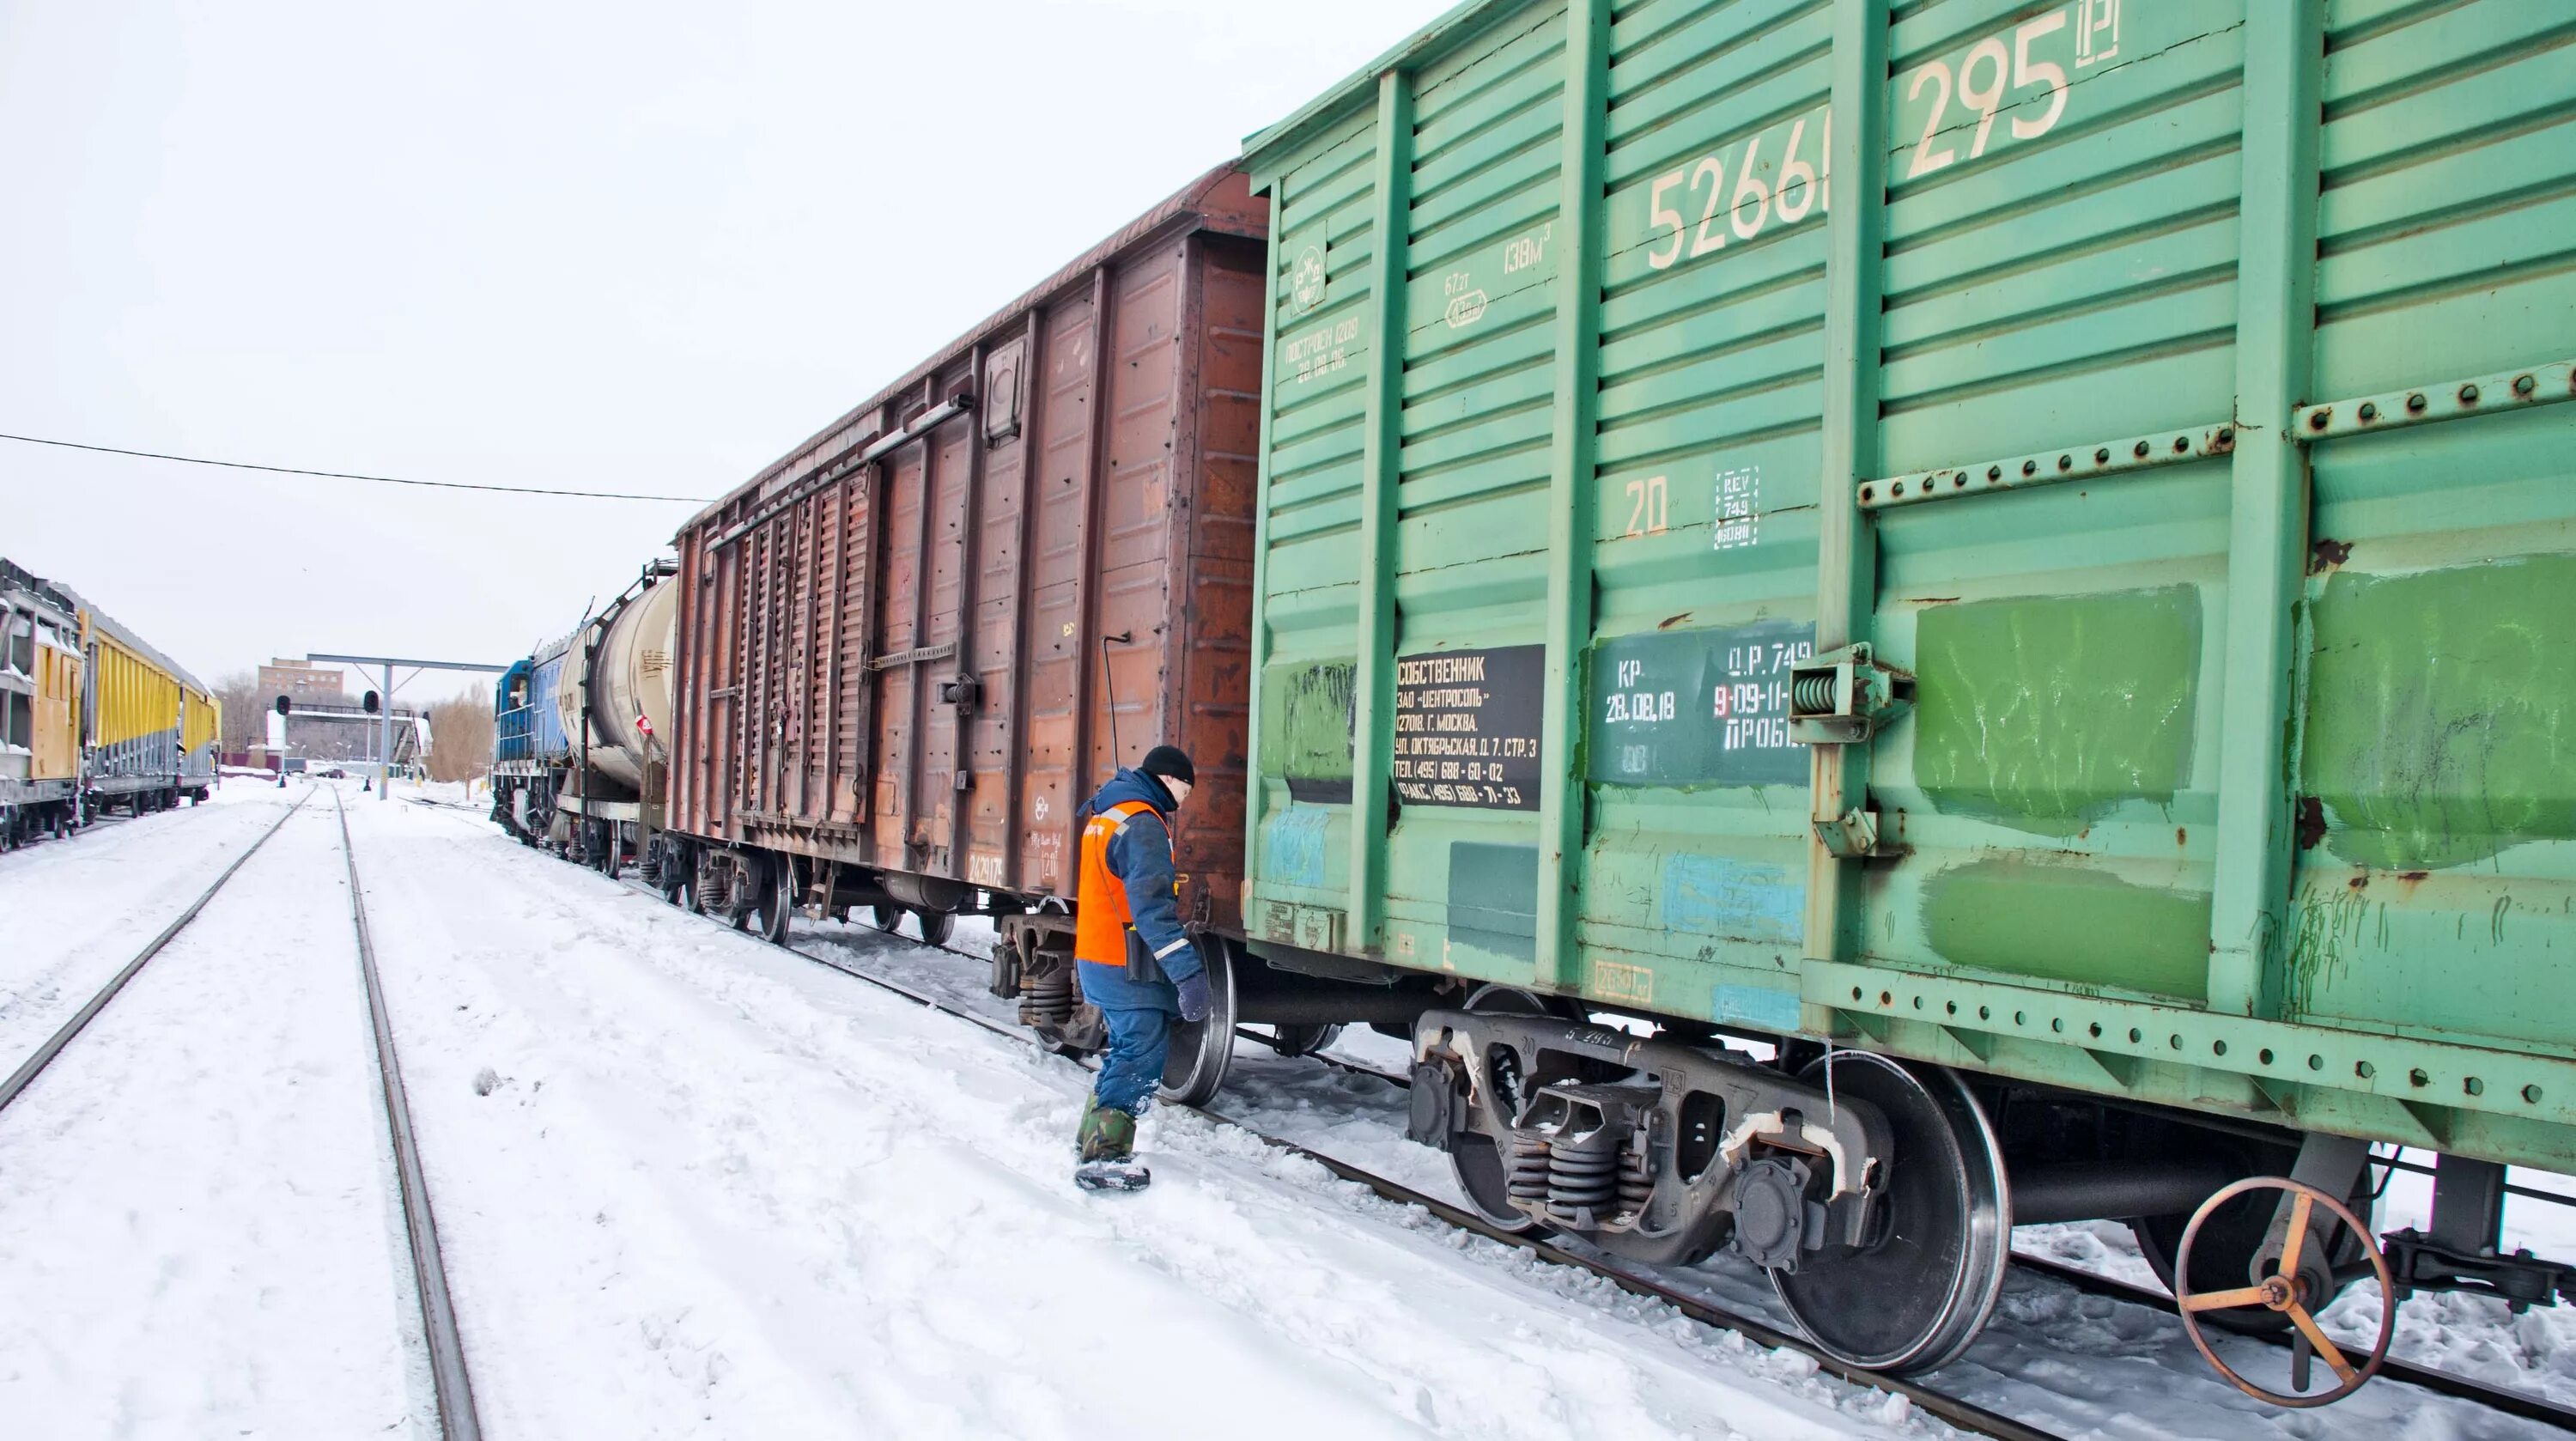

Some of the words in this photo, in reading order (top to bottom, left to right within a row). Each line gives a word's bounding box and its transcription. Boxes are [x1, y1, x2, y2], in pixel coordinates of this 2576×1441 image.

[1649, 108, 1831, 270] 5266
[1907, 10, 2068, 179] 295
[1285, 327, 1333, 365] ПОСТРОЕН
[1724, 475, 1749, 494] REV
[1625, 475, 1668, 538] 20
[1724, 500, 1748, 517] 749
[1397, 656, 1485, 685] СОБСТВЕННИК
[1397, 691, 1414, 708] ЗАО
[1417, 688, 1490, 708] «ЦЕНТРОСОЛЬ»
[1606, 691, 1674, 723] 28.08.18
[1394, 737, 1409, 755] УЛ.
[1504, 738, 1527, 757] СТР.
[1529, 739, 1537, 757] 3
